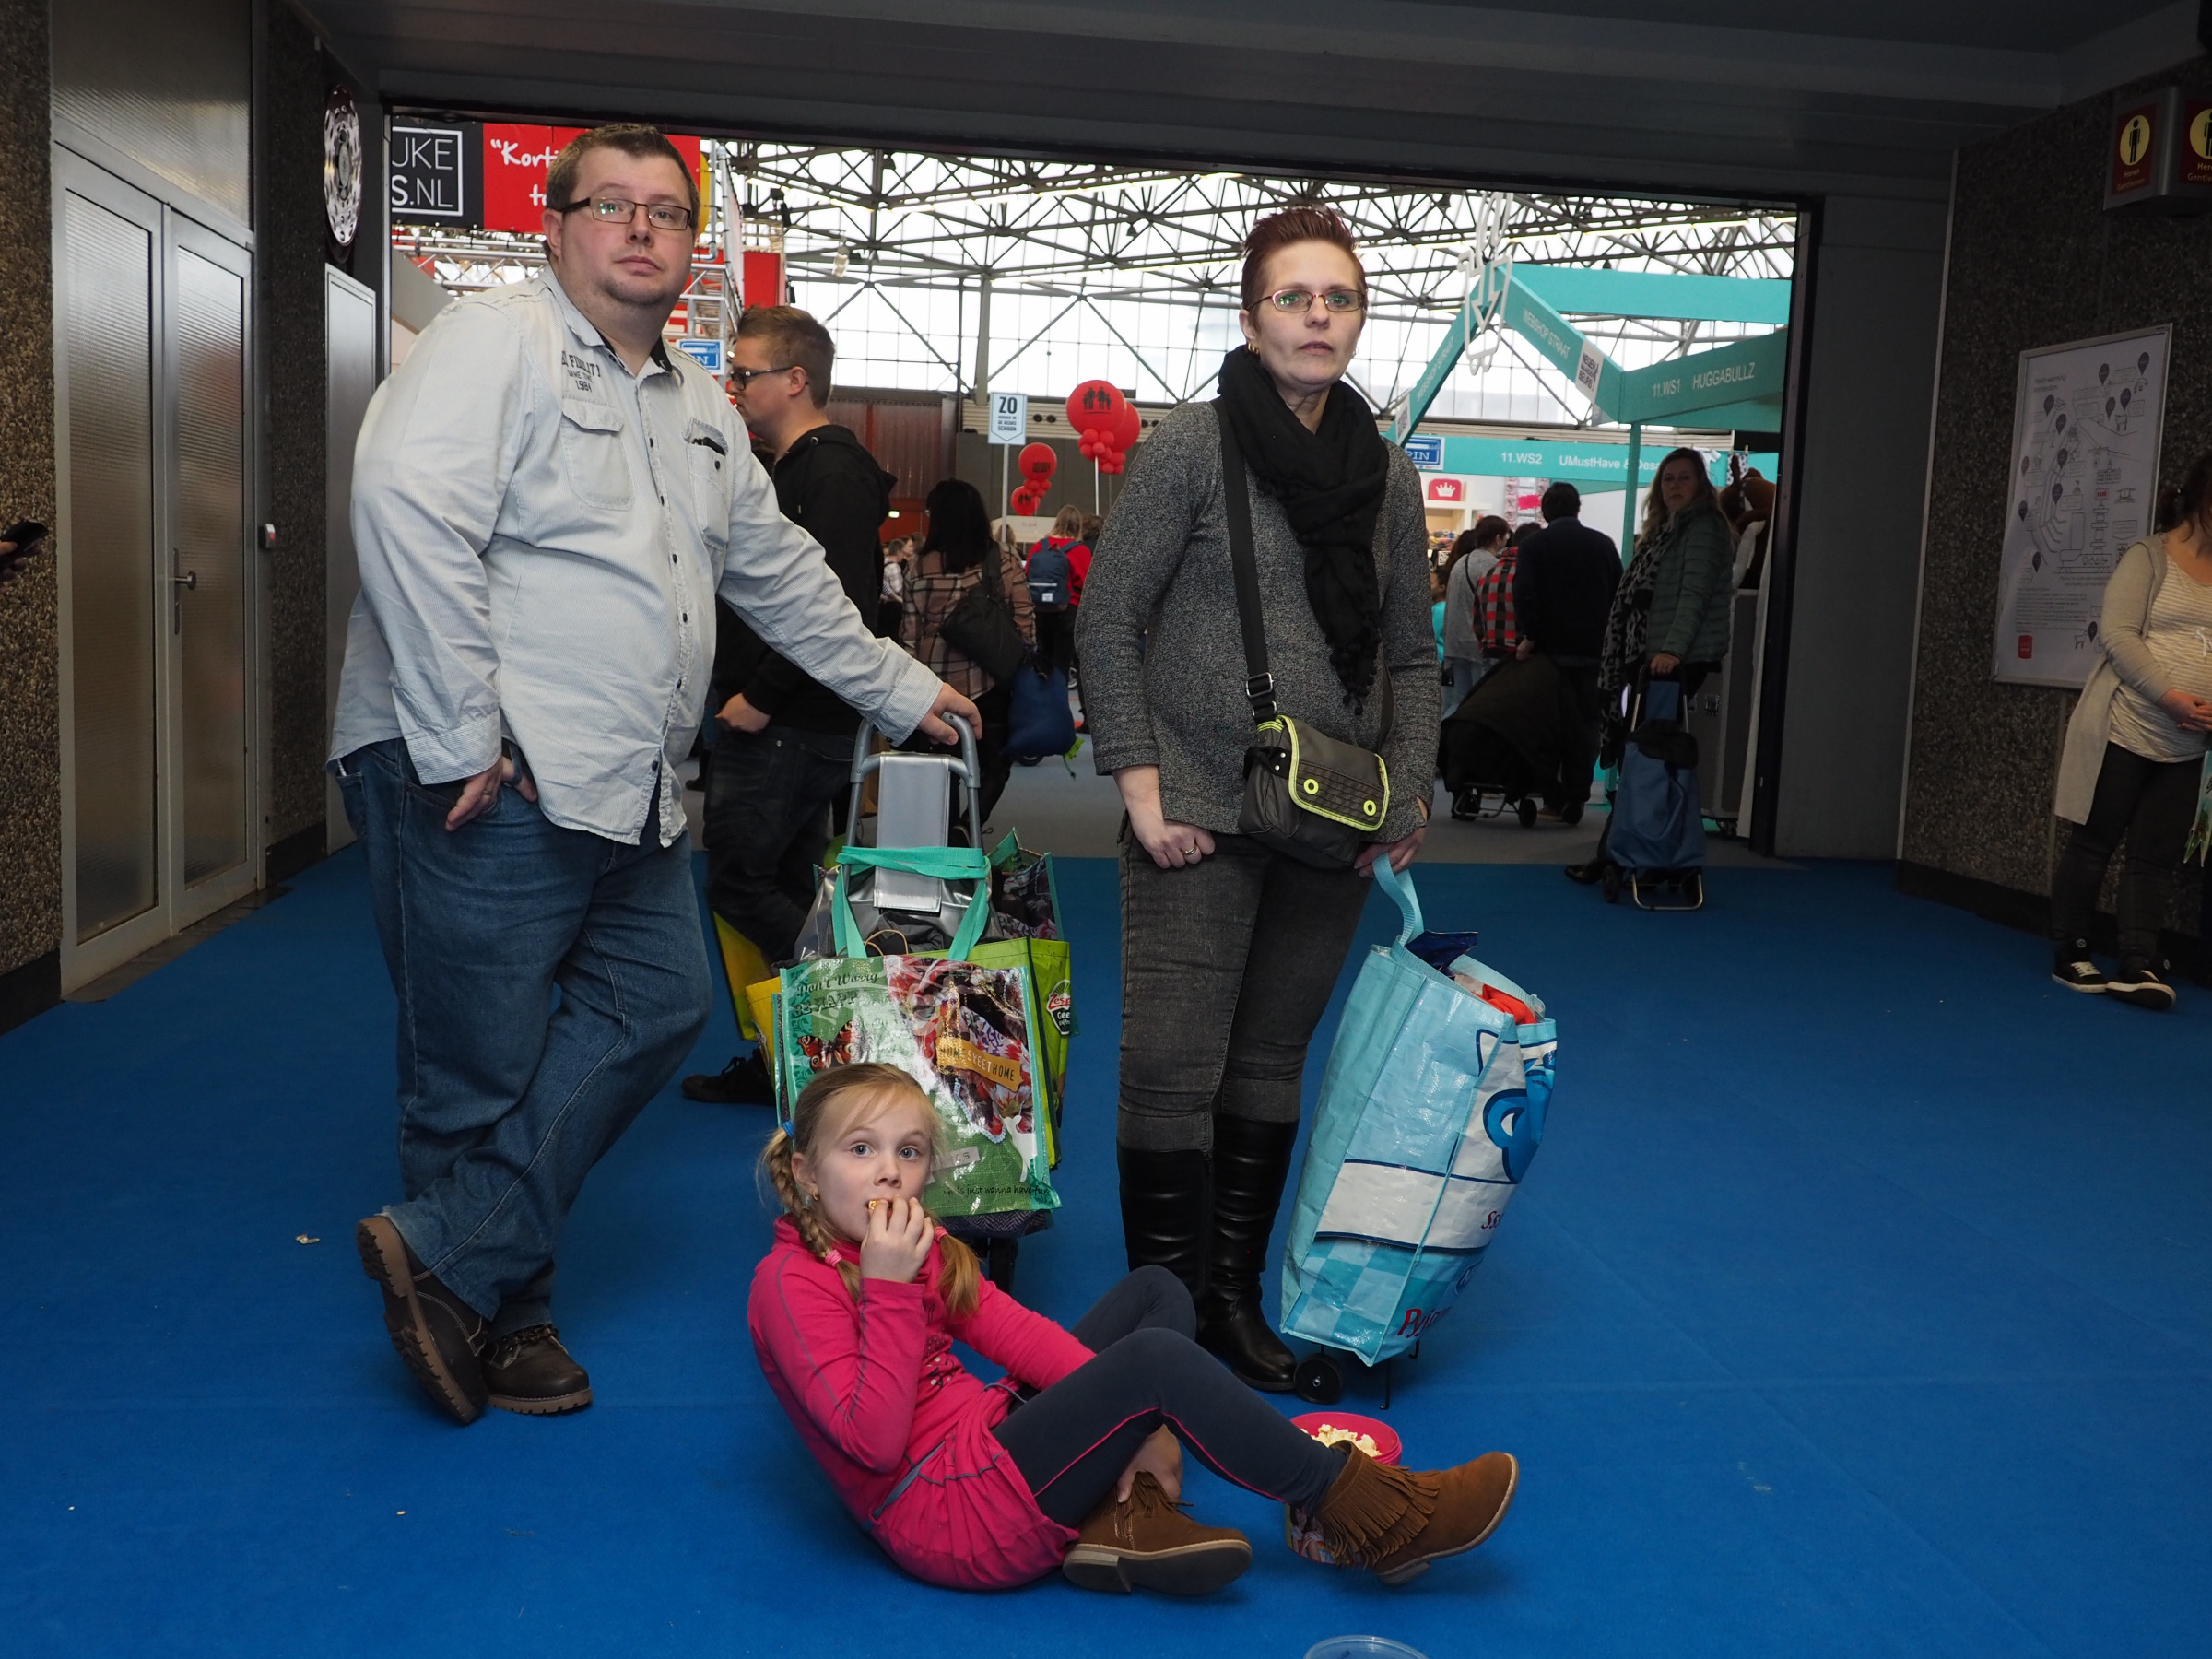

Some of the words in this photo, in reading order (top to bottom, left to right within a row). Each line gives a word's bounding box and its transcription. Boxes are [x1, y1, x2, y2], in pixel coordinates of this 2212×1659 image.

[392, 174, 453, 207] S.NL
[1548, 331, 1570, 359] STRAAT
[575, 380, 592, 393] 1984
[1653, 378, 1681, 397] 11.WS1
[1692, 362, 1756, 389] HUGGABULLZ
[999, 396, 1018, 414] ZO
[1501, 452, 1543, 465] 11.WS2
[1559, 454, 1621, 469] UMustHave
[797, 981, 831, 996] Don't
[835, 972, 878, 986] Worry
[967, 1051, 992, 1073] SWEET
[992, 1064, 1015, 1081] HOME
[967, 1186, 982, 1198] just
[1014, 1184, 1031, 1194] have
